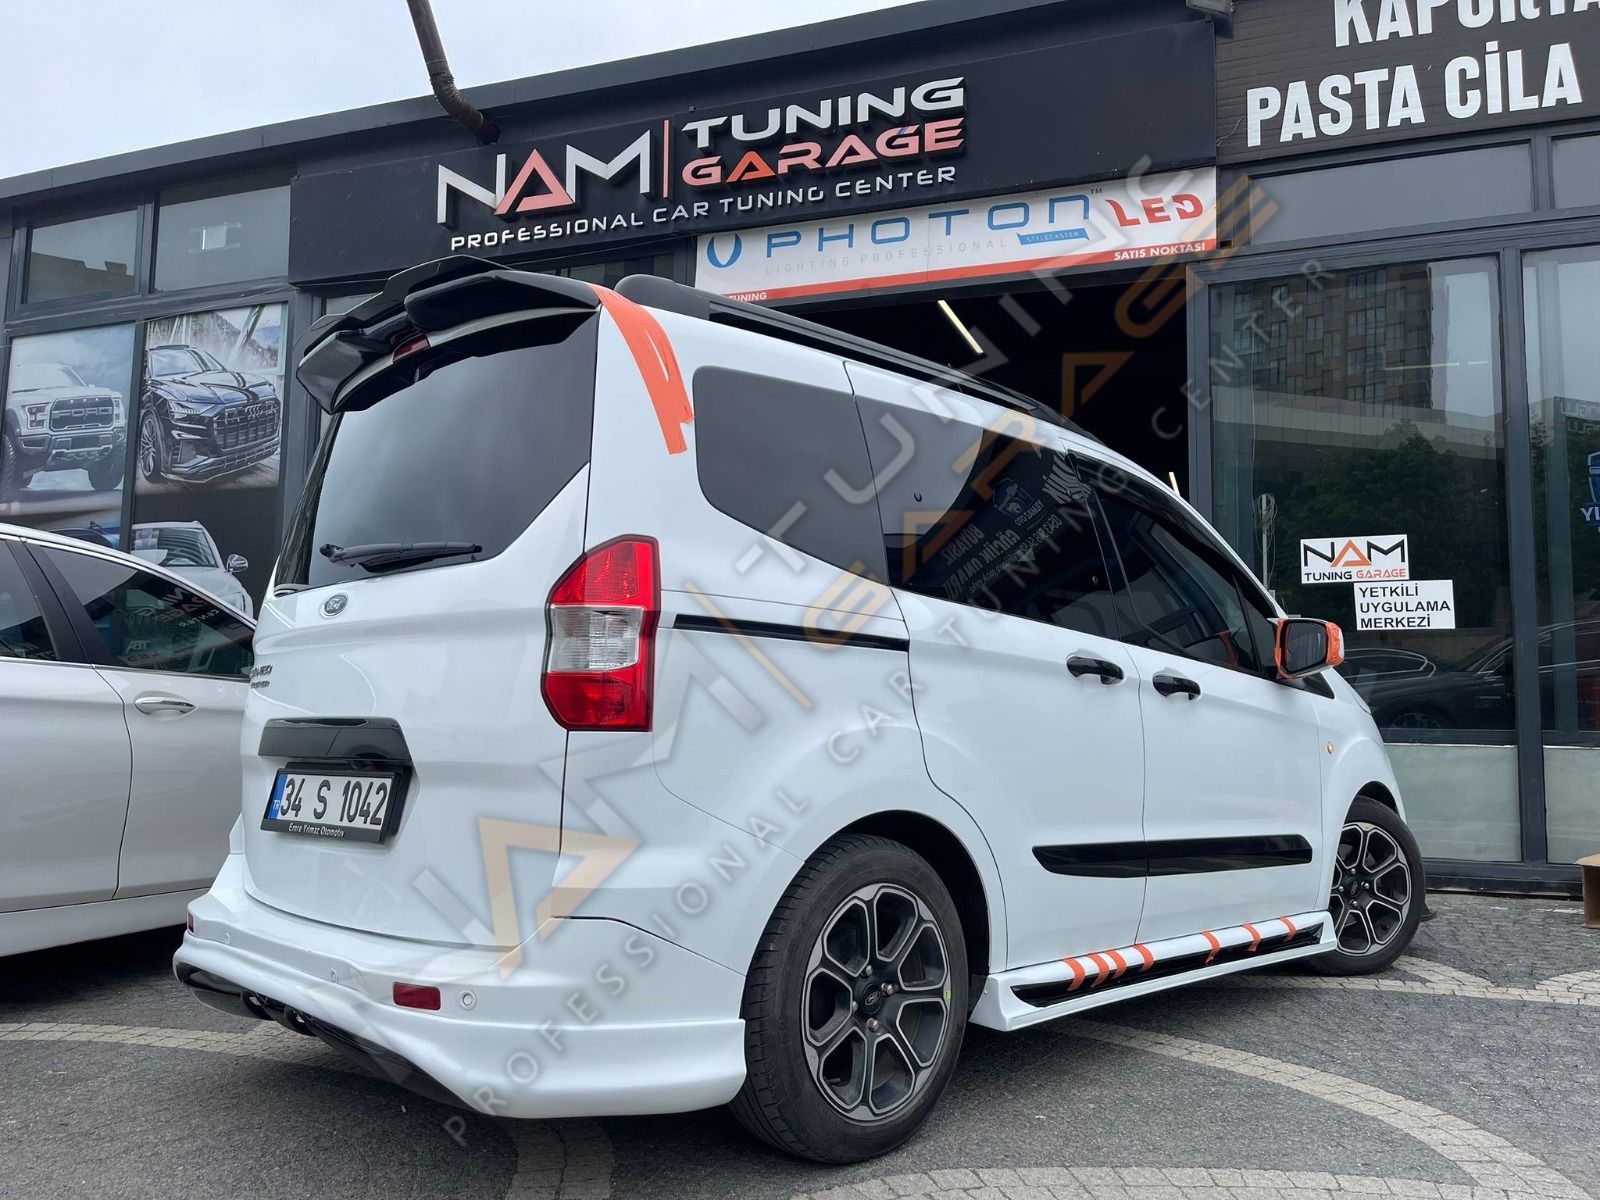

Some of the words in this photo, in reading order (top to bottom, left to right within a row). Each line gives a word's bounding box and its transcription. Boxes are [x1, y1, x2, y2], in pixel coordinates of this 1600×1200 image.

[1247, 65, 1425, 147] PASTA
[1444, 40, 1583, 119] CİLA
[681, 76, 965, 148] TUNING
[682, 117, 965, 186] GARAGE
[437, 130, 651, 223] NAM
[451, 212, 644, 251] PROFESSIONAL
[653, 201, 709, 222] CAR
[719, 185, 825, 213] TUNING
[836, 166, 957, 197] CENTER
[1105, 193, 1204, 227] LED
[766, 256, 850, 275] LIGHTING
[860, 238, 1008, 264] PROFESSIONAL
[1303, 538, 1405, 568] NAM
[1304, 570, 1353, 582] TUNING
[1356, 568, 1407, 579] GARAGE
[1359, 583, 1419, 598] YETKİLİ
[1360, 600, 1452, 613] UYGULAMA
[1361, 614, 1431, 629] MERKEZİ
[280, 778, 305, 817] 34
[313, 779, 331, 819] S
[339, 781, 388, 825] 1042
[288, 823, 302, 832] Emre
